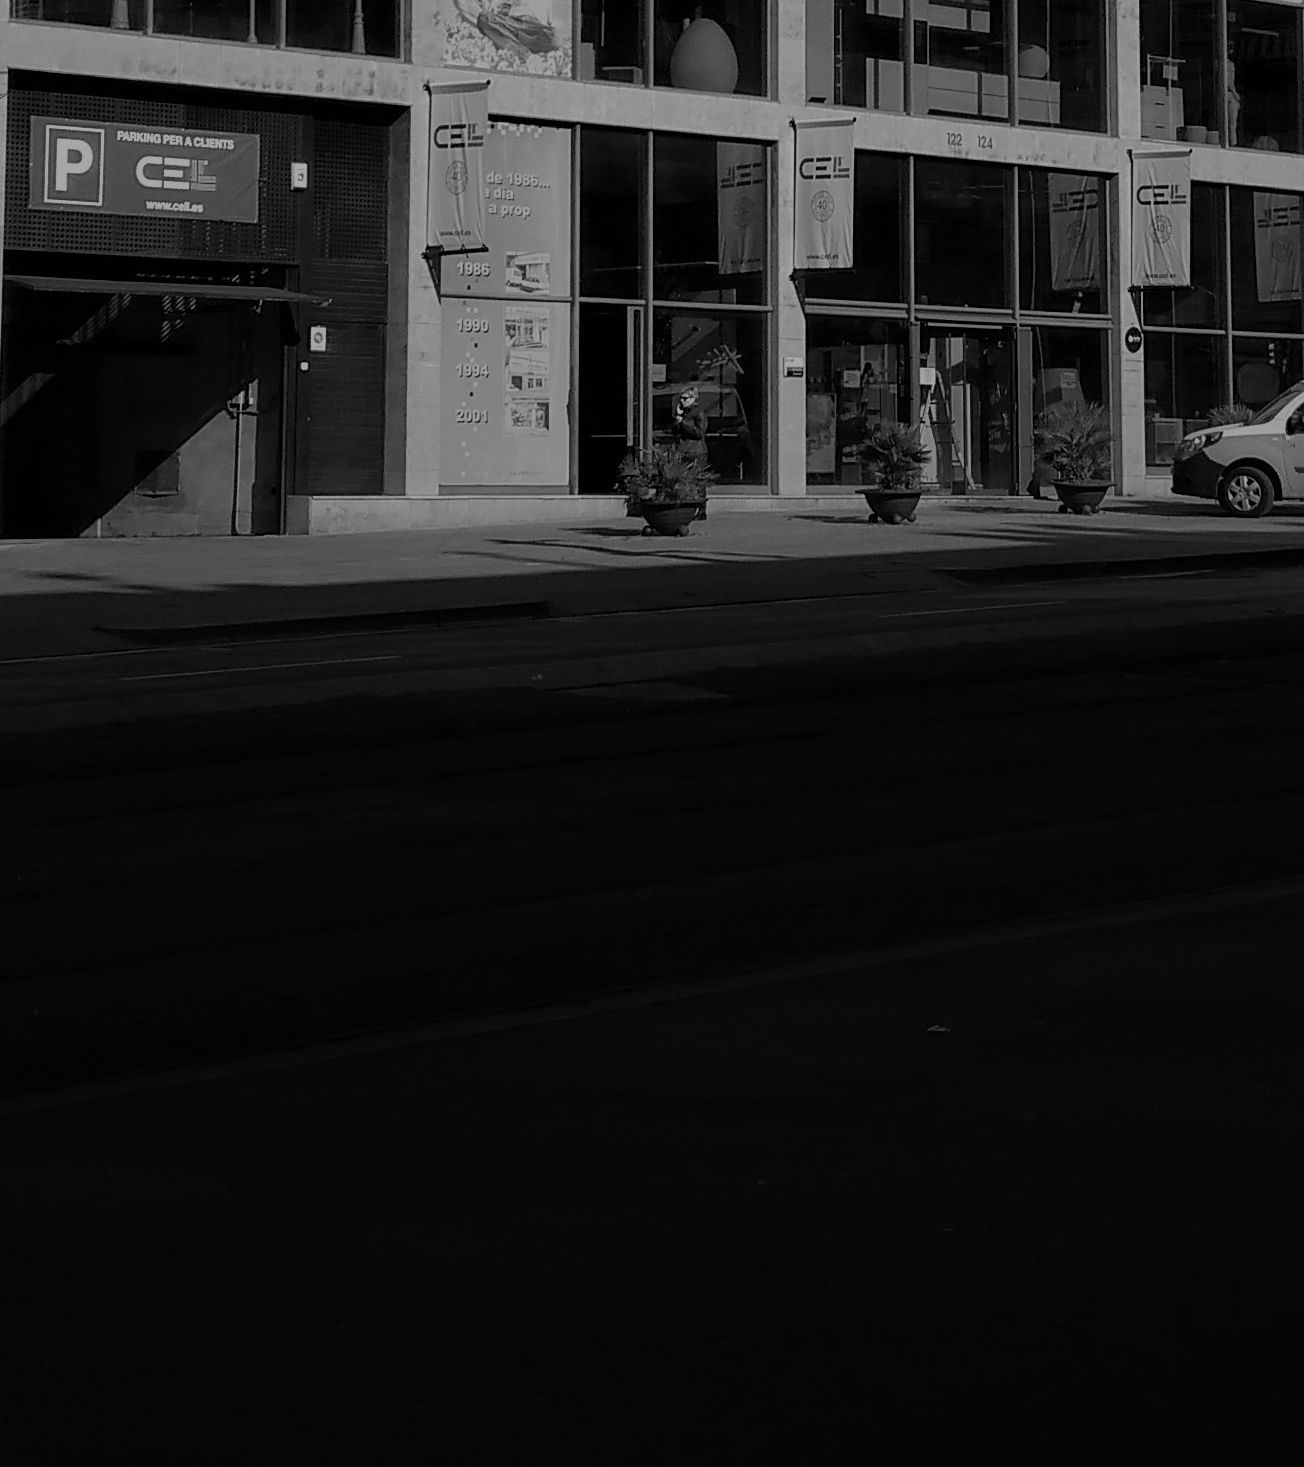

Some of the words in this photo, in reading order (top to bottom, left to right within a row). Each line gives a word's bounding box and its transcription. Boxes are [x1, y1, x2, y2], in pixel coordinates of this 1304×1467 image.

[116, 130, 161, 144] PARKING
[163, 134, 183, 146] PER
[184, 136, 192, 146] A
[193, 137, 234, 150] CLIENTS
[947, 132, 962, 146] 122
[977, 135, 993, 149] 124
[55, 138, 93, 191] P
[486, 172, 503, 184] de
[494, 187, 515, 201] dia
[501, 205, 531, 220] prop
[456, 262, 491, 277] 1986
[455, 319, 490, 334] 1990
[455, 363, 490, 379] 1994
[455, 409, 489, 424] 2001
